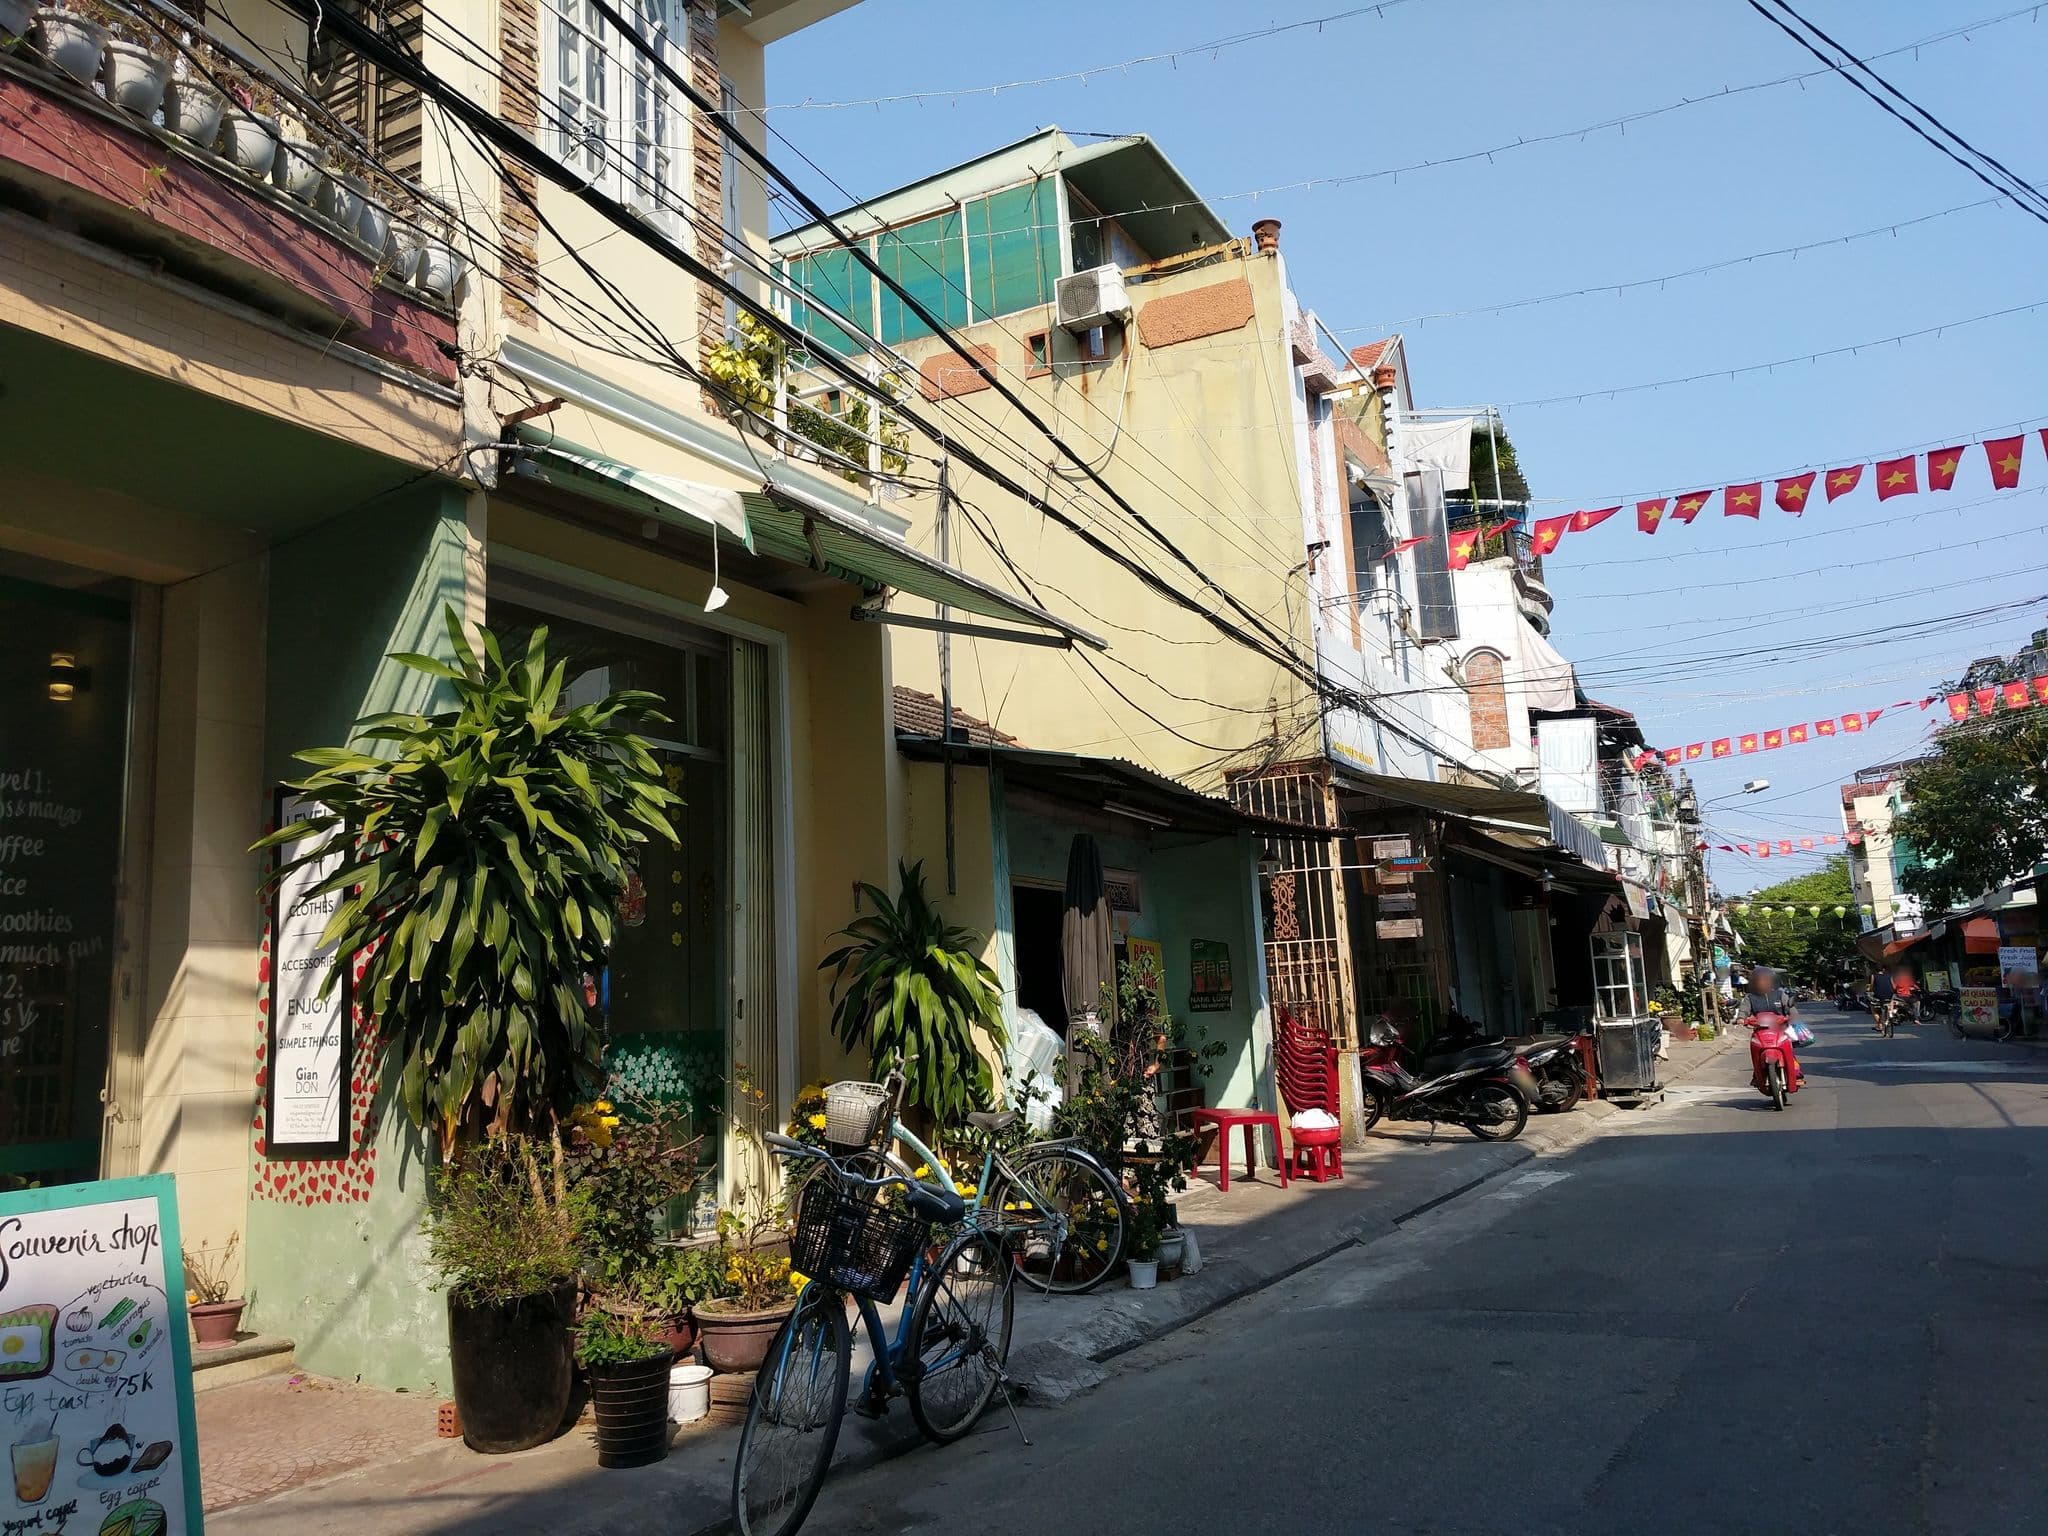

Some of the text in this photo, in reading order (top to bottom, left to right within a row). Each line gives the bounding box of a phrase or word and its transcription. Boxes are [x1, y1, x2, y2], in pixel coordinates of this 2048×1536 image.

[289, 900, 334, 917] CLOTHES
[281, 955, 337, 972] ACCESSORIE
[287, 997, 331, 1016] ENJOY
[301, 1022, 313, 1031] THE
[279, 1035, 339, 1050] SIMPLE THINGS
[296, 1067, 318, 1081] Gian
[295, 1081, 319, 1094] DON
[0, 1212, 159, 1292] Souvenir shop
[44, 1389, 90, 1411] toast
[99, 1475, 161, 1511] Egg coffee
